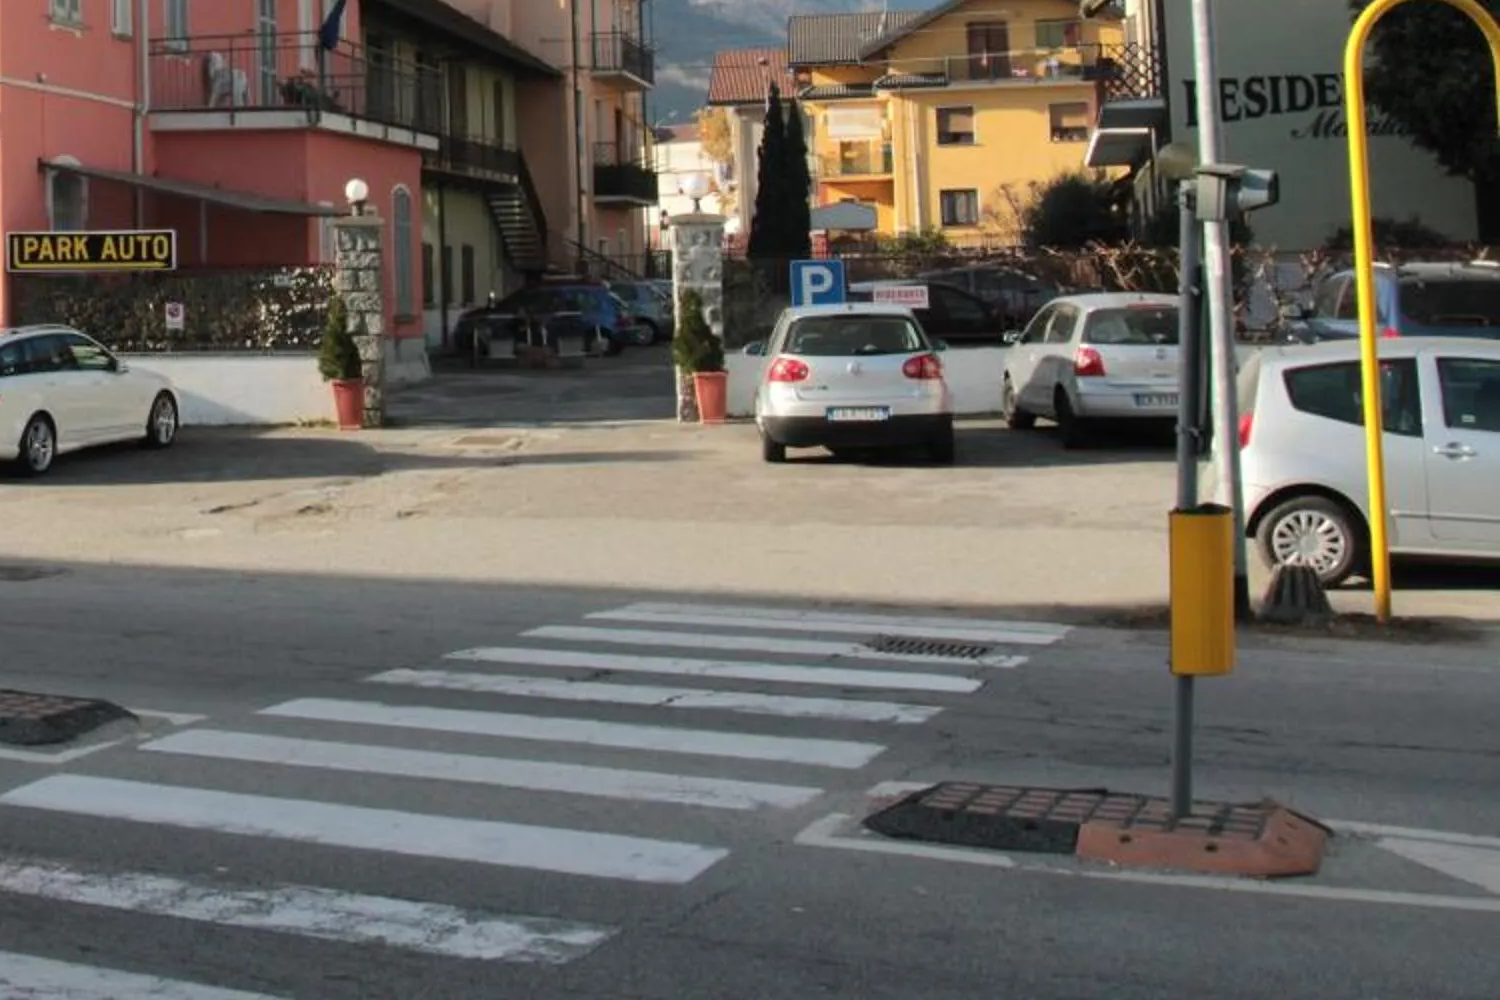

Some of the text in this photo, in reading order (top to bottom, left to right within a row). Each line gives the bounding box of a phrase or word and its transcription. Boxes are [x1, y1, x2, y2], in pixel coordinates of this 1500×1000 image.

[23, 235, 169, 261] PARK AUTO
[801, 265, 833, 307] P
